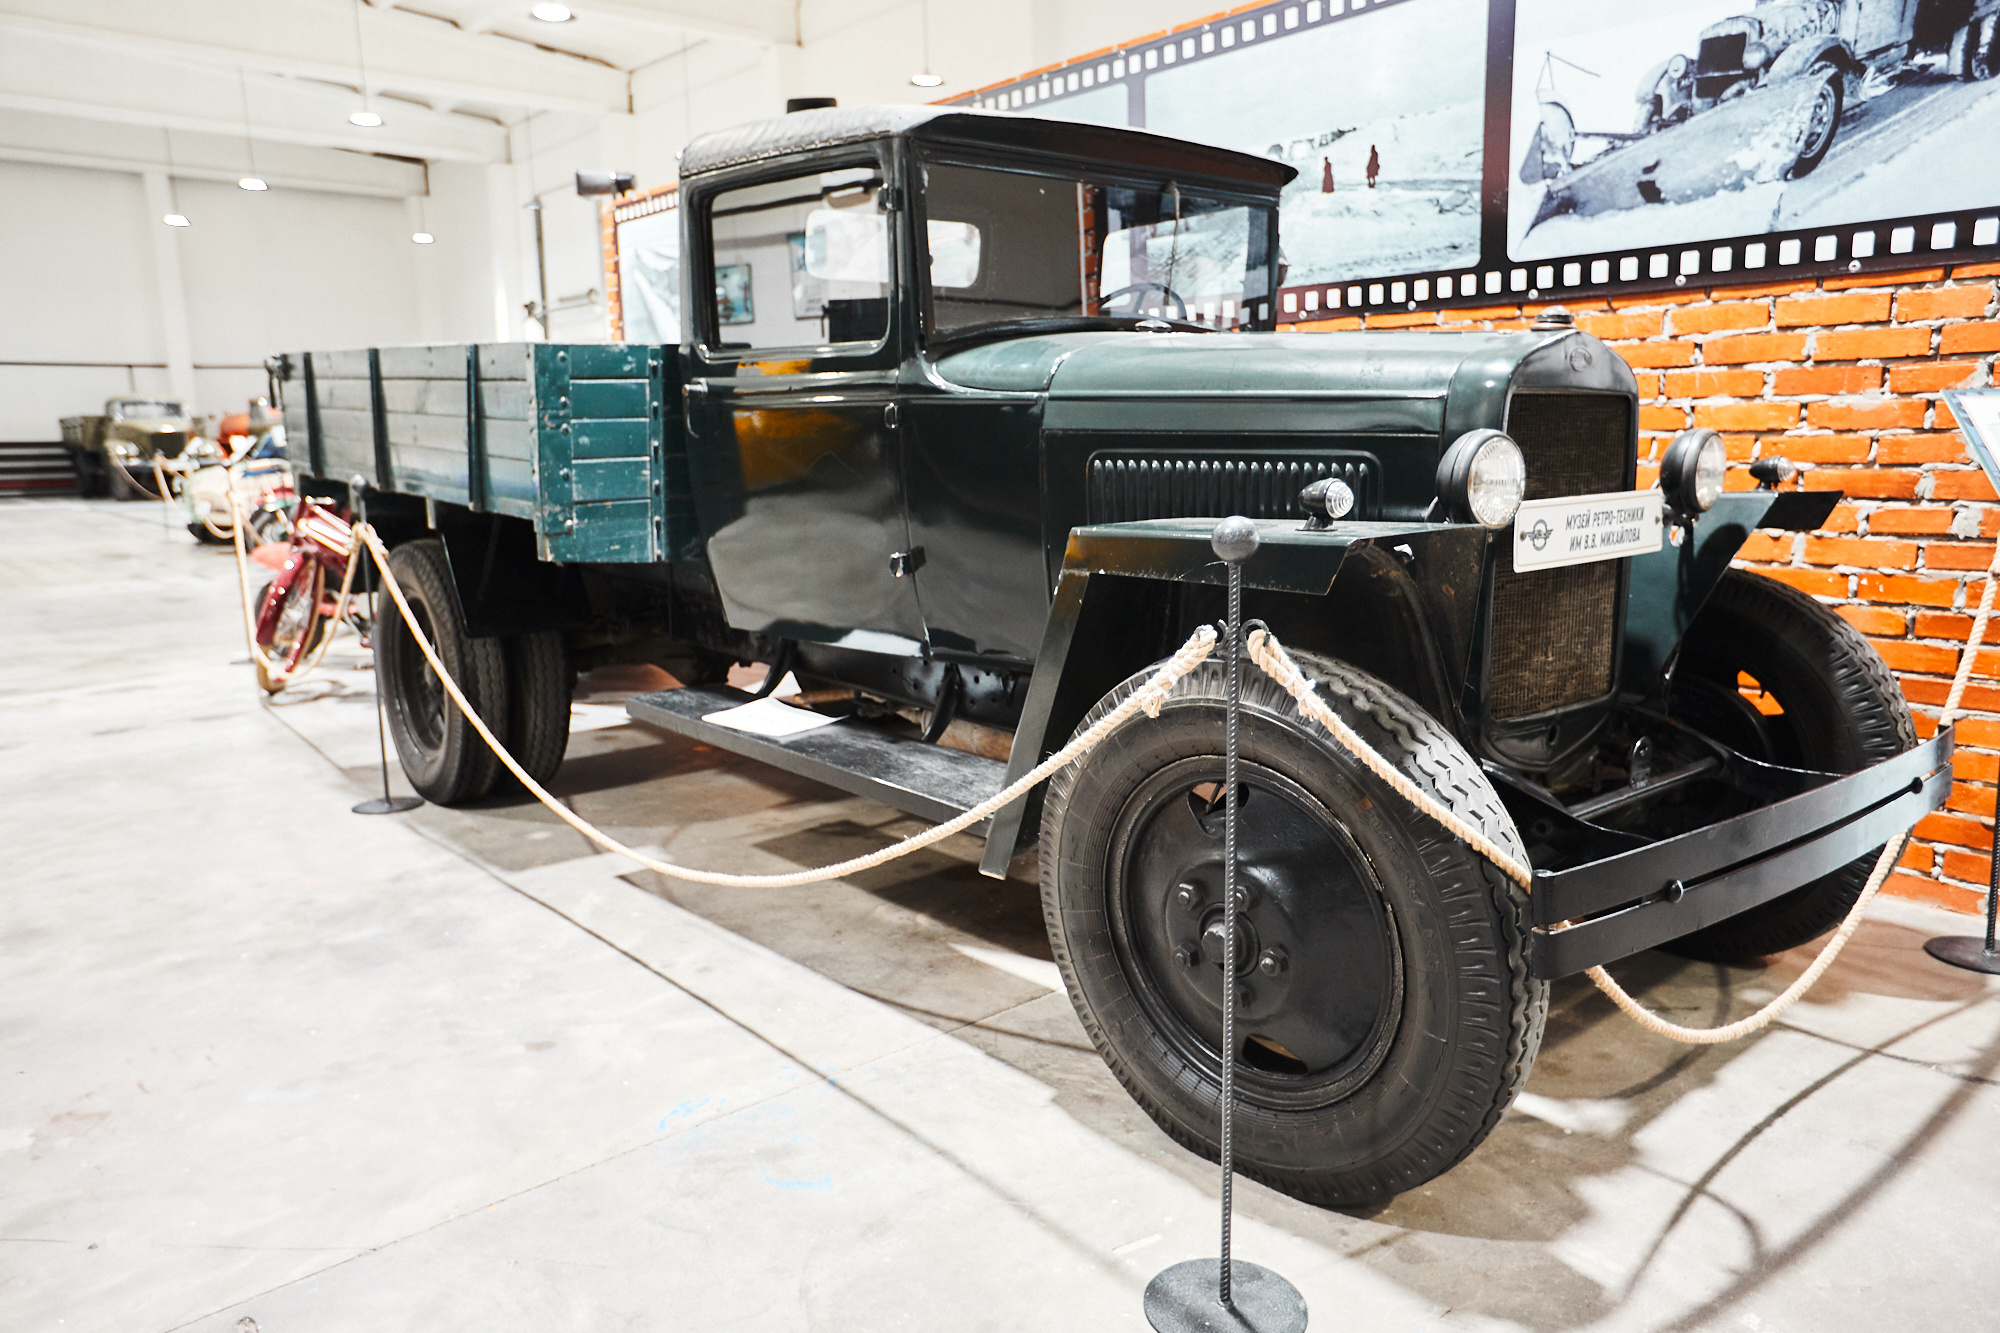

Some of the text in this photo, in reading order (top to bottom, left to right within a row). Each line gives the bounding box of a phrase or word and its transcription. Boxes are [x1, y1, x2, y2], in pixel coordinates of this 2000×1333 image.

[1565, 507, 1645, 531] МУЗЕЙ РЕТРО-ТЕХНИКИ
[1569, 526, 1641, 552] ИМ В.В. МИХАЙЛОВА
